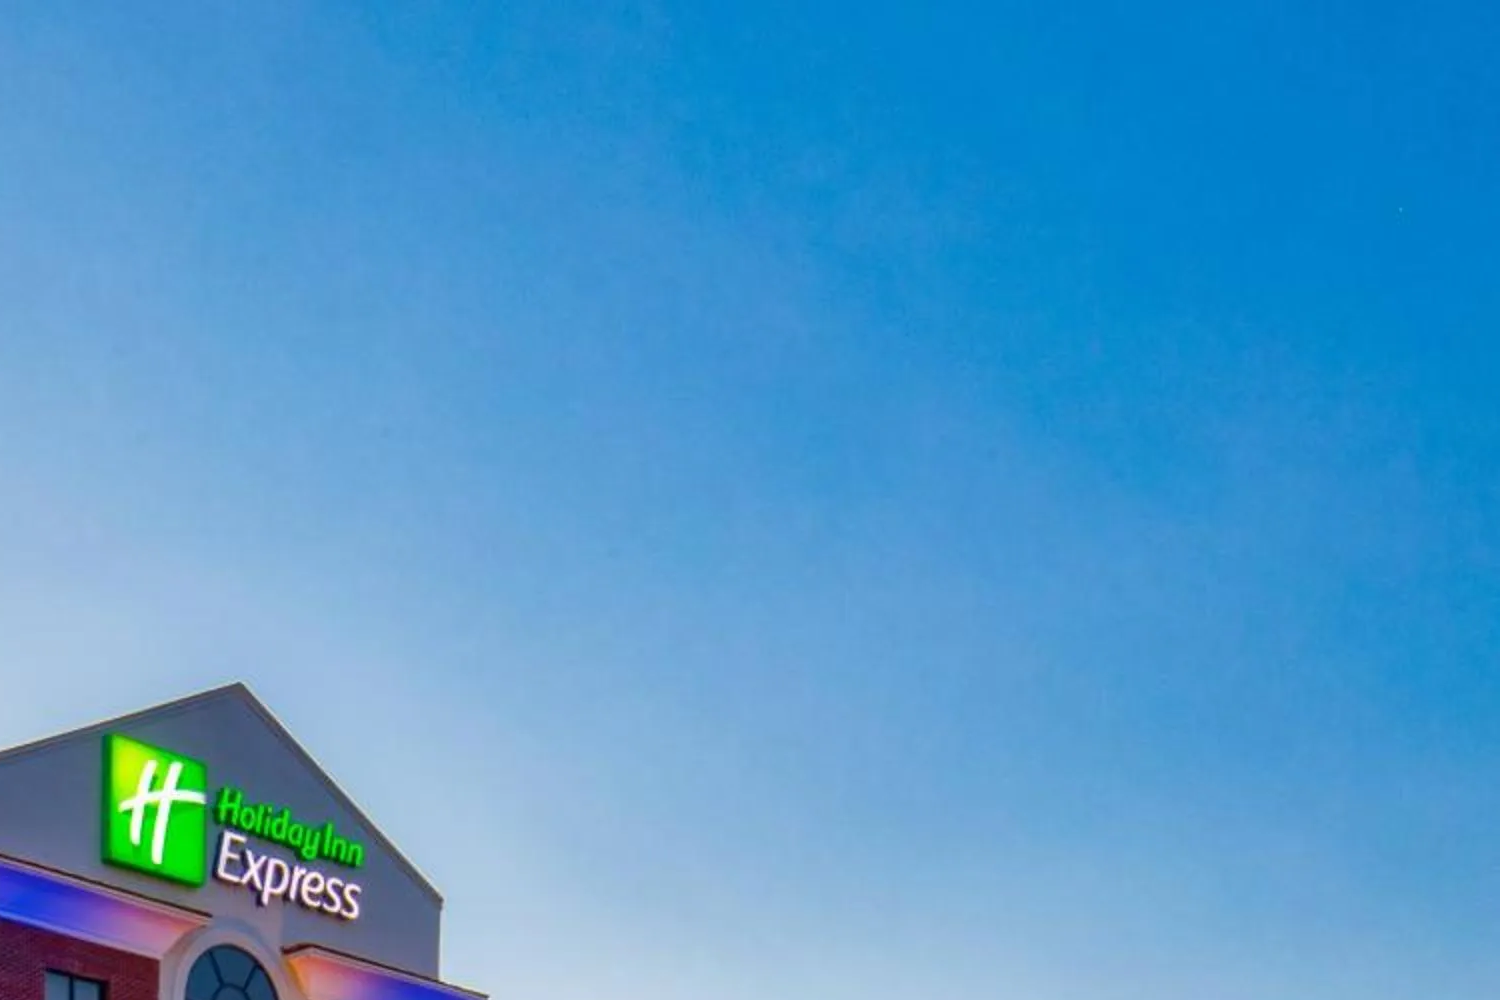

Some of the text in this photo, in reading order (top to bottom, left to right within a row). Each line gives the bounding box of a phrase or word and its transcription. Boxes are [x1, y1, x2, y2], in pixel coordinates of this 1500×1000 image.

[119, 759, 207, 865] H
[217, 786, 365, 867] Holiday Inn
[217, 830, 362, 919] Express
